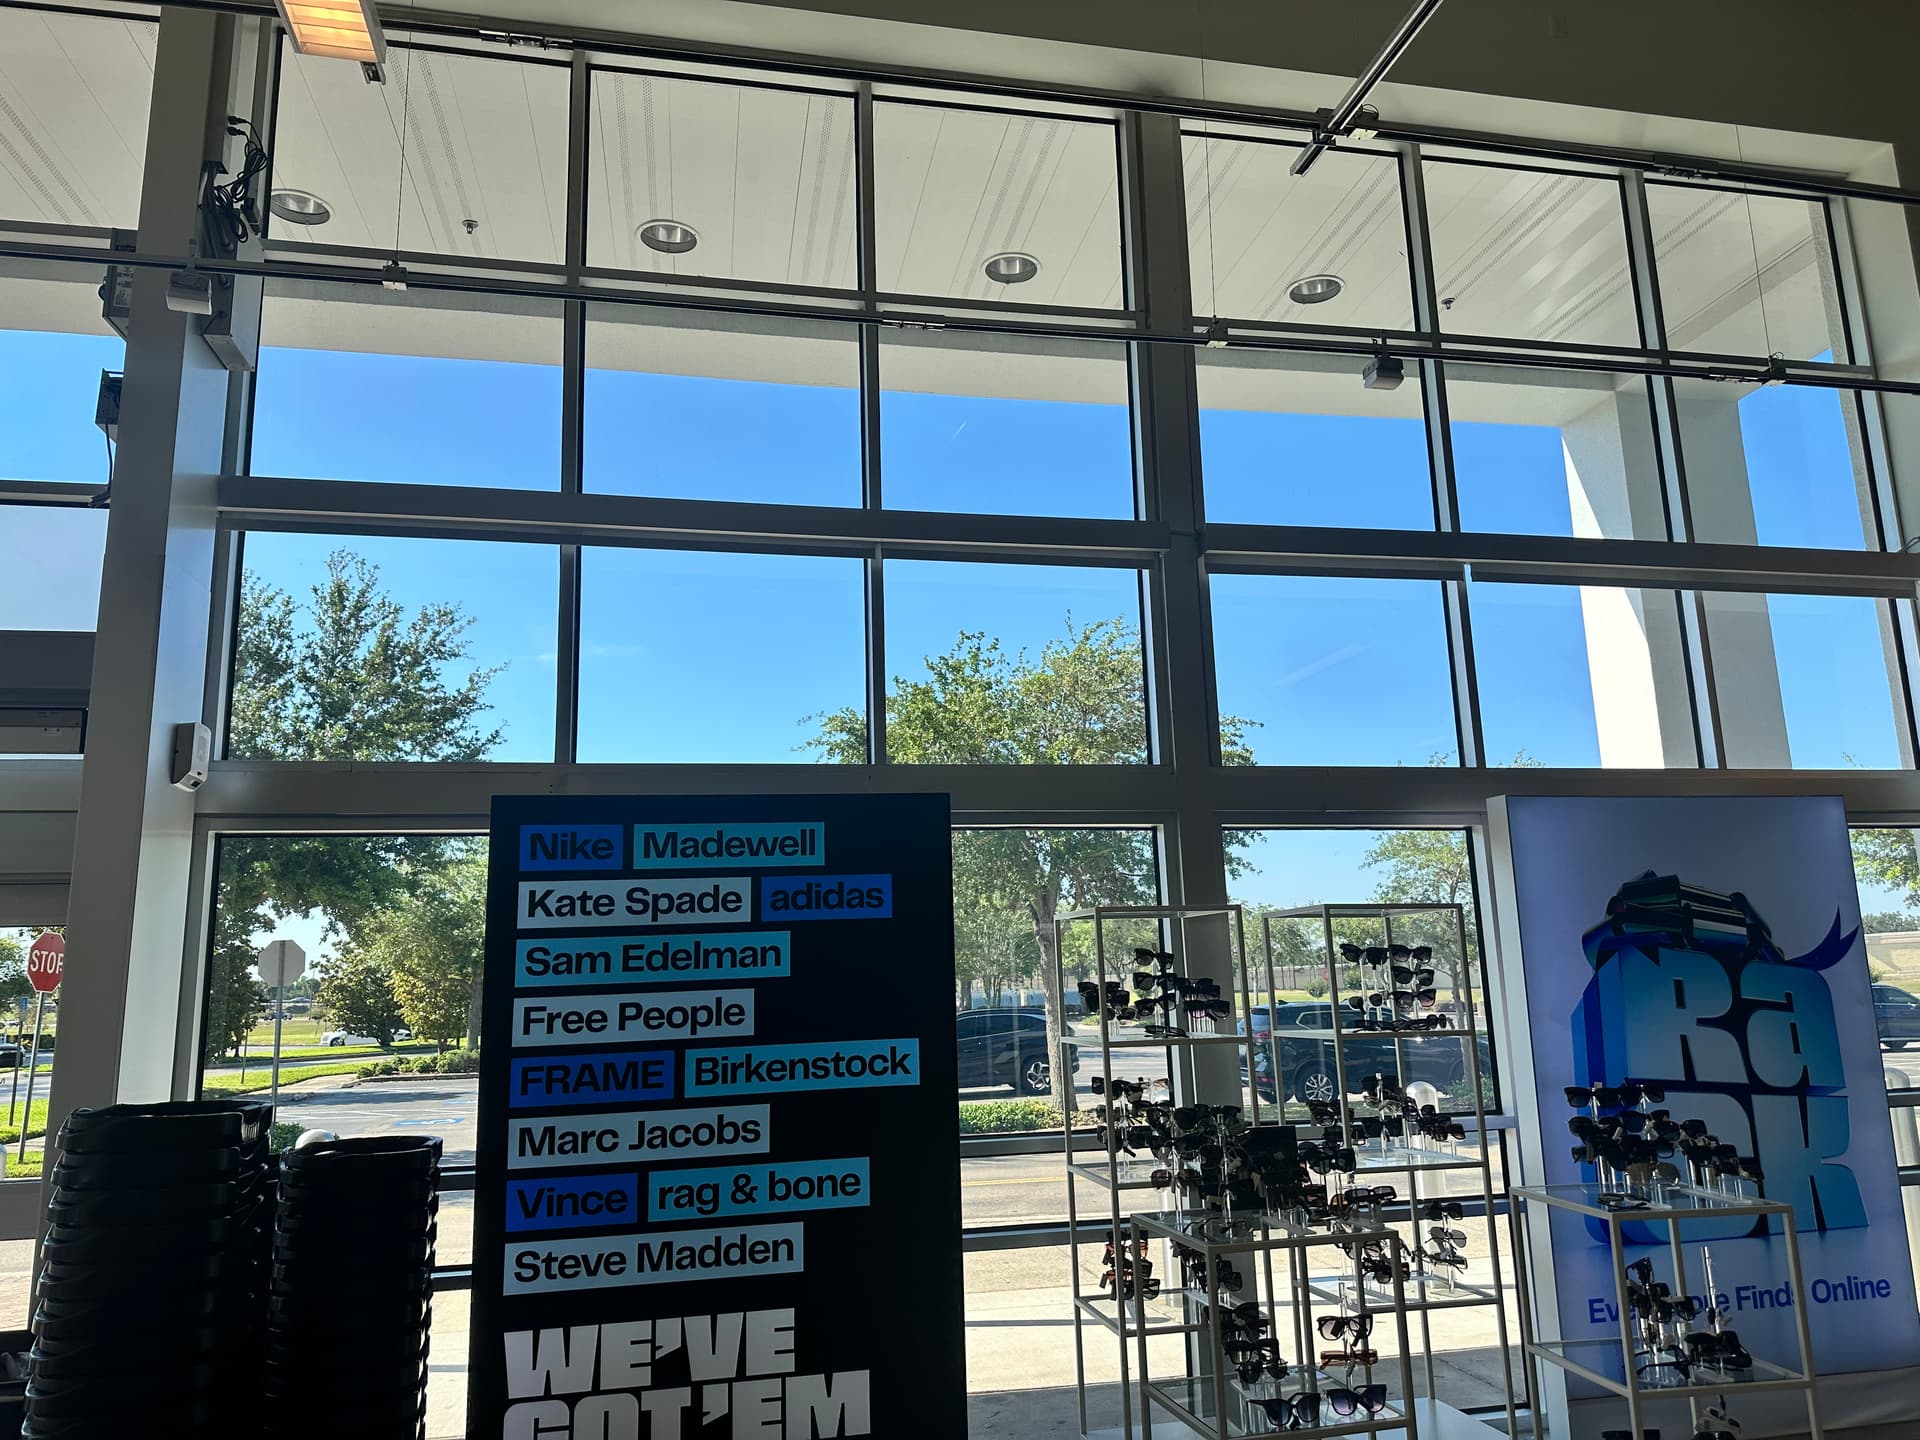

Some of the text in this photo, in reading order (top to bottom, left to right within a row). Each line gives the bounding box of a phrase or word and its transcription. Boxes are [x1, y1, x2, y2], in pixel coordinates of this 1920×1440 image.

[529, 831, 614, 861] Nike
[643, 829, 816, 859] Madewell
[527, 884, 742, 922] Kate Spade
[769, 882, 884, 911] adidas
[525, 941, 781, 977] Sam Edelman
[522, 998, 746, 1036] Free People
[520, 1060, 665, 1096] FRAME
[695, 1046, 912, 1086] Birkenstock
[518, 1114, 761, 1157] Marc Jacobs
[517, 1187, 628, 1218] Vince
[658, 1169, 861, 1214] rag & bone
[514, 1234, 794, 1282] Steve Madden
[1736, 1281, 1794, 1311] Find
[1811, 1275, 1891, 1304] Online
